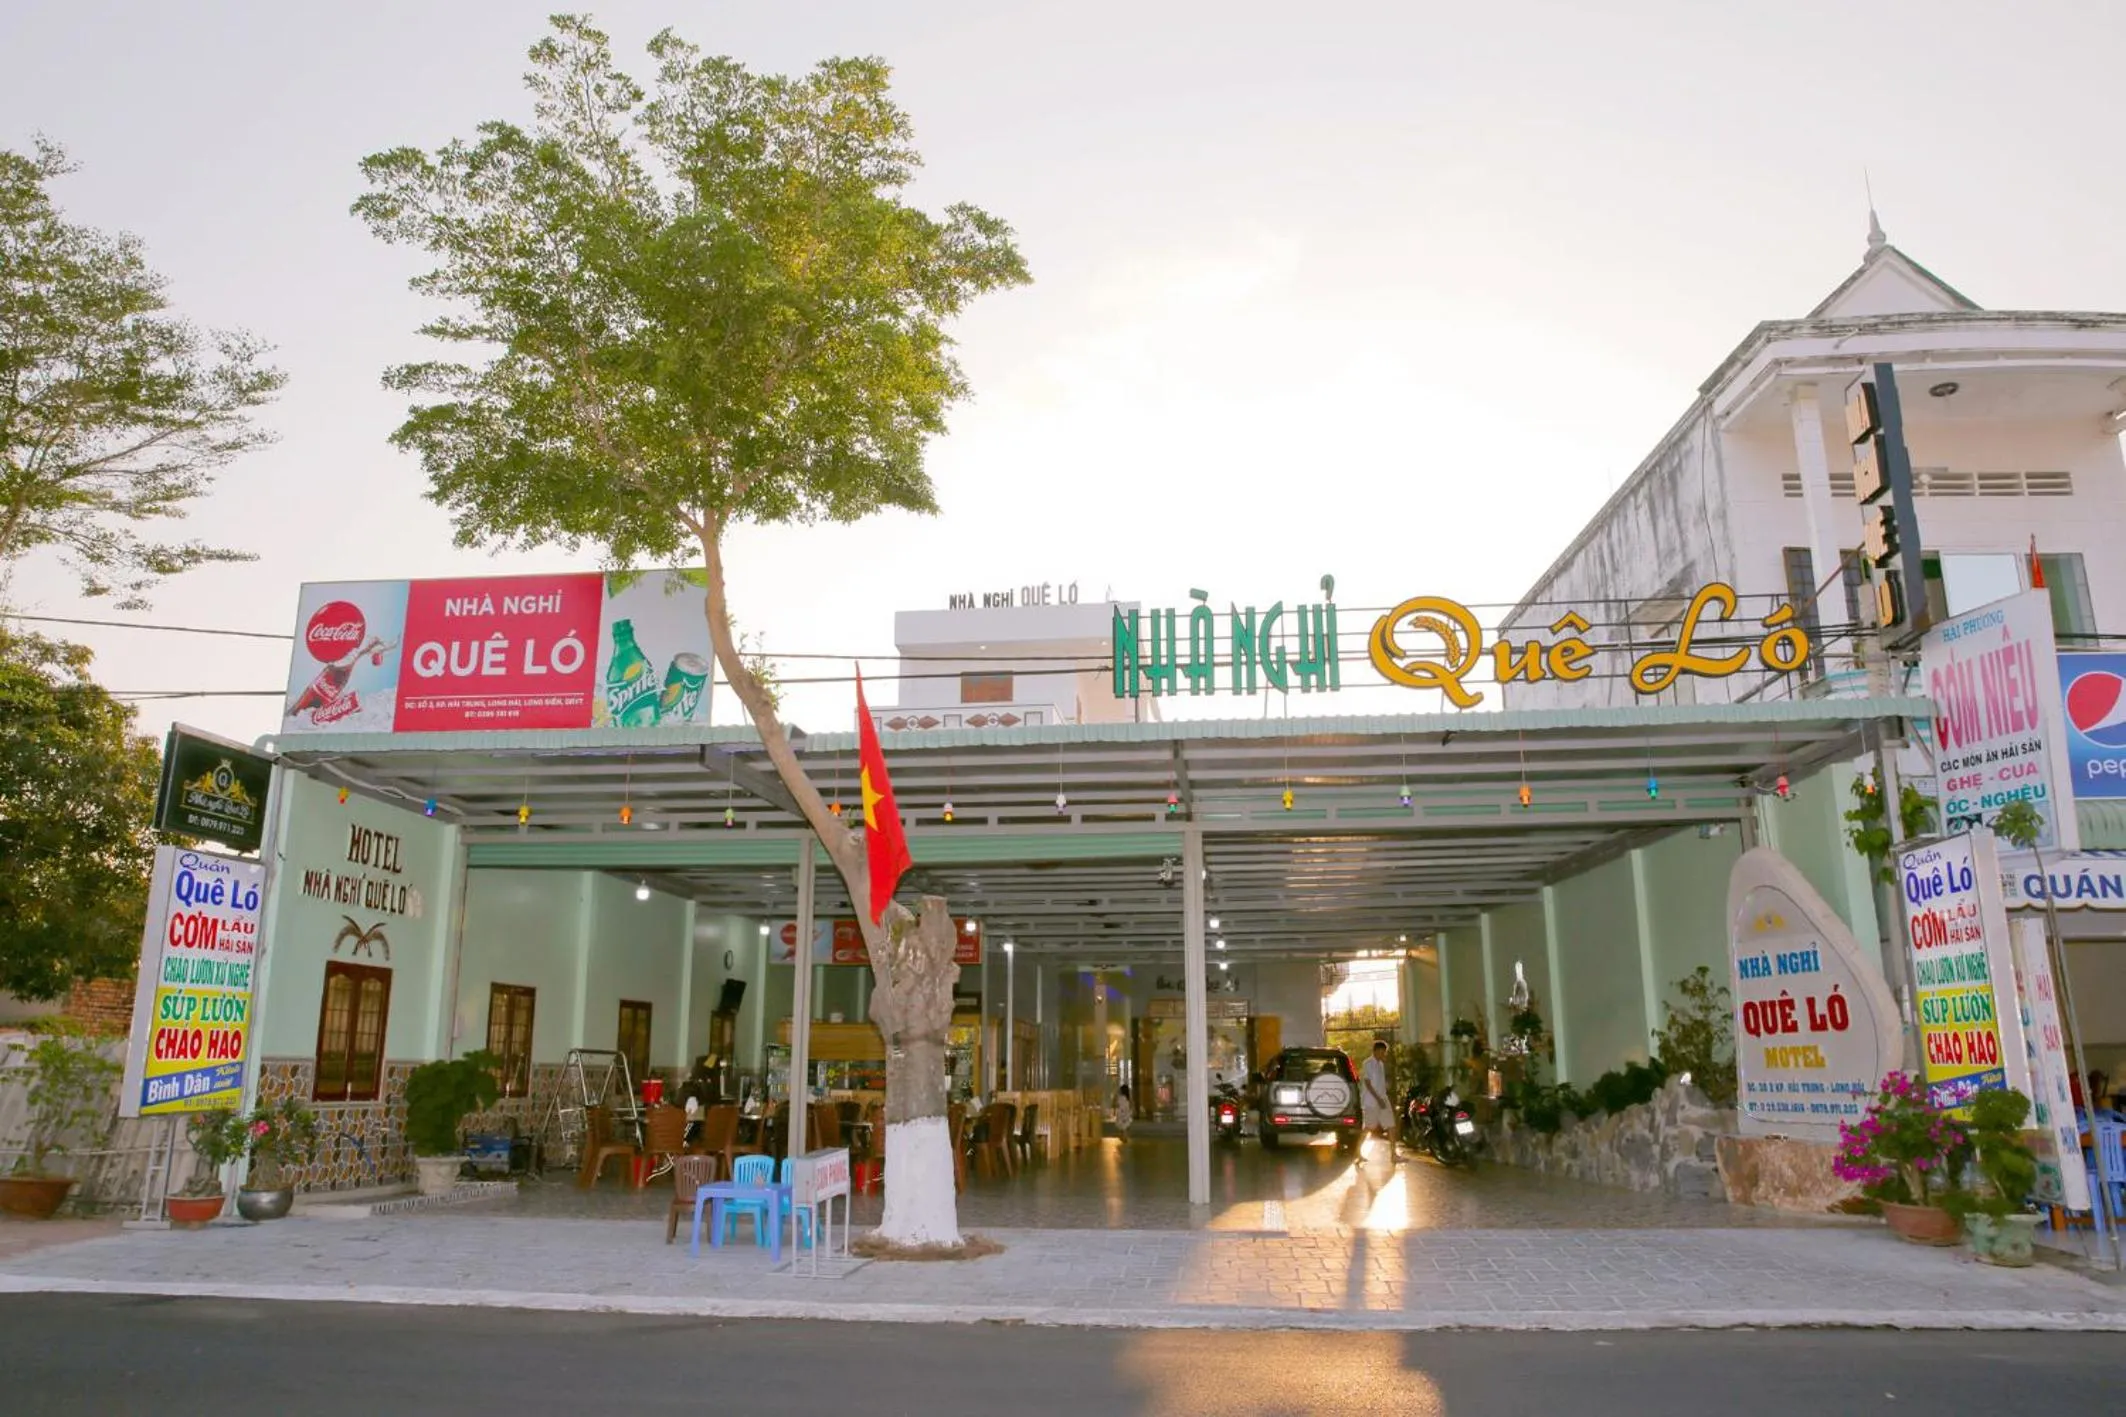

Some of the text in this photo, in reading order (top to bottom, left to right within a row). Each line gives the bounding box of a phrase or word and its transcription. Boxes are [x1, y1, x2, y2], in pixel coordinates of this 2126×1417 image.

[445, 588, 562, 617] NHÀ NGHỈ
[949, 580, 1079, 611] NHÀ NGHỈ QUÊ LÓ
[412, 629, 586, 679] QUÊ LÓ
[1112, 574, 1341, 699] NHÀ NGHỈ
[1368, 582, 1811, 709] Quê Ló
[1932, 646, 1983, 752] CƠM
[1998, 760, 2039, 781] CUA
[1946, 795, 1970, 815] ỐC
[179, 852, 231, 875] Quán
[346, 823, 402, 874] MOTEL
[1902, 850, 1942, 870] Quán
[175, 869, 259, 912] Quê Ló
[1905, 867, 1944, 907] Quê
[1946, 856, 1973, 894] Ló
[2023, 868, 2125, 900] QUÁN
[168, 910, 219, 951] CƠM
[1910, 907, 1948, 951] CƠM
[1738, 941, 1821, 980] NHÀ NGHỈ
[160, 988, 198, 1021] SÚP
[1742, 983, 1850, 1038] QUÊ LÓ
[1922, 990, 1949, 1024] SÚP
[1763, 1044, 1826, 1069] MOTEL
[147, 1076, 180, 1104] Bình
[183, 1072, 211, 1097] Dân
